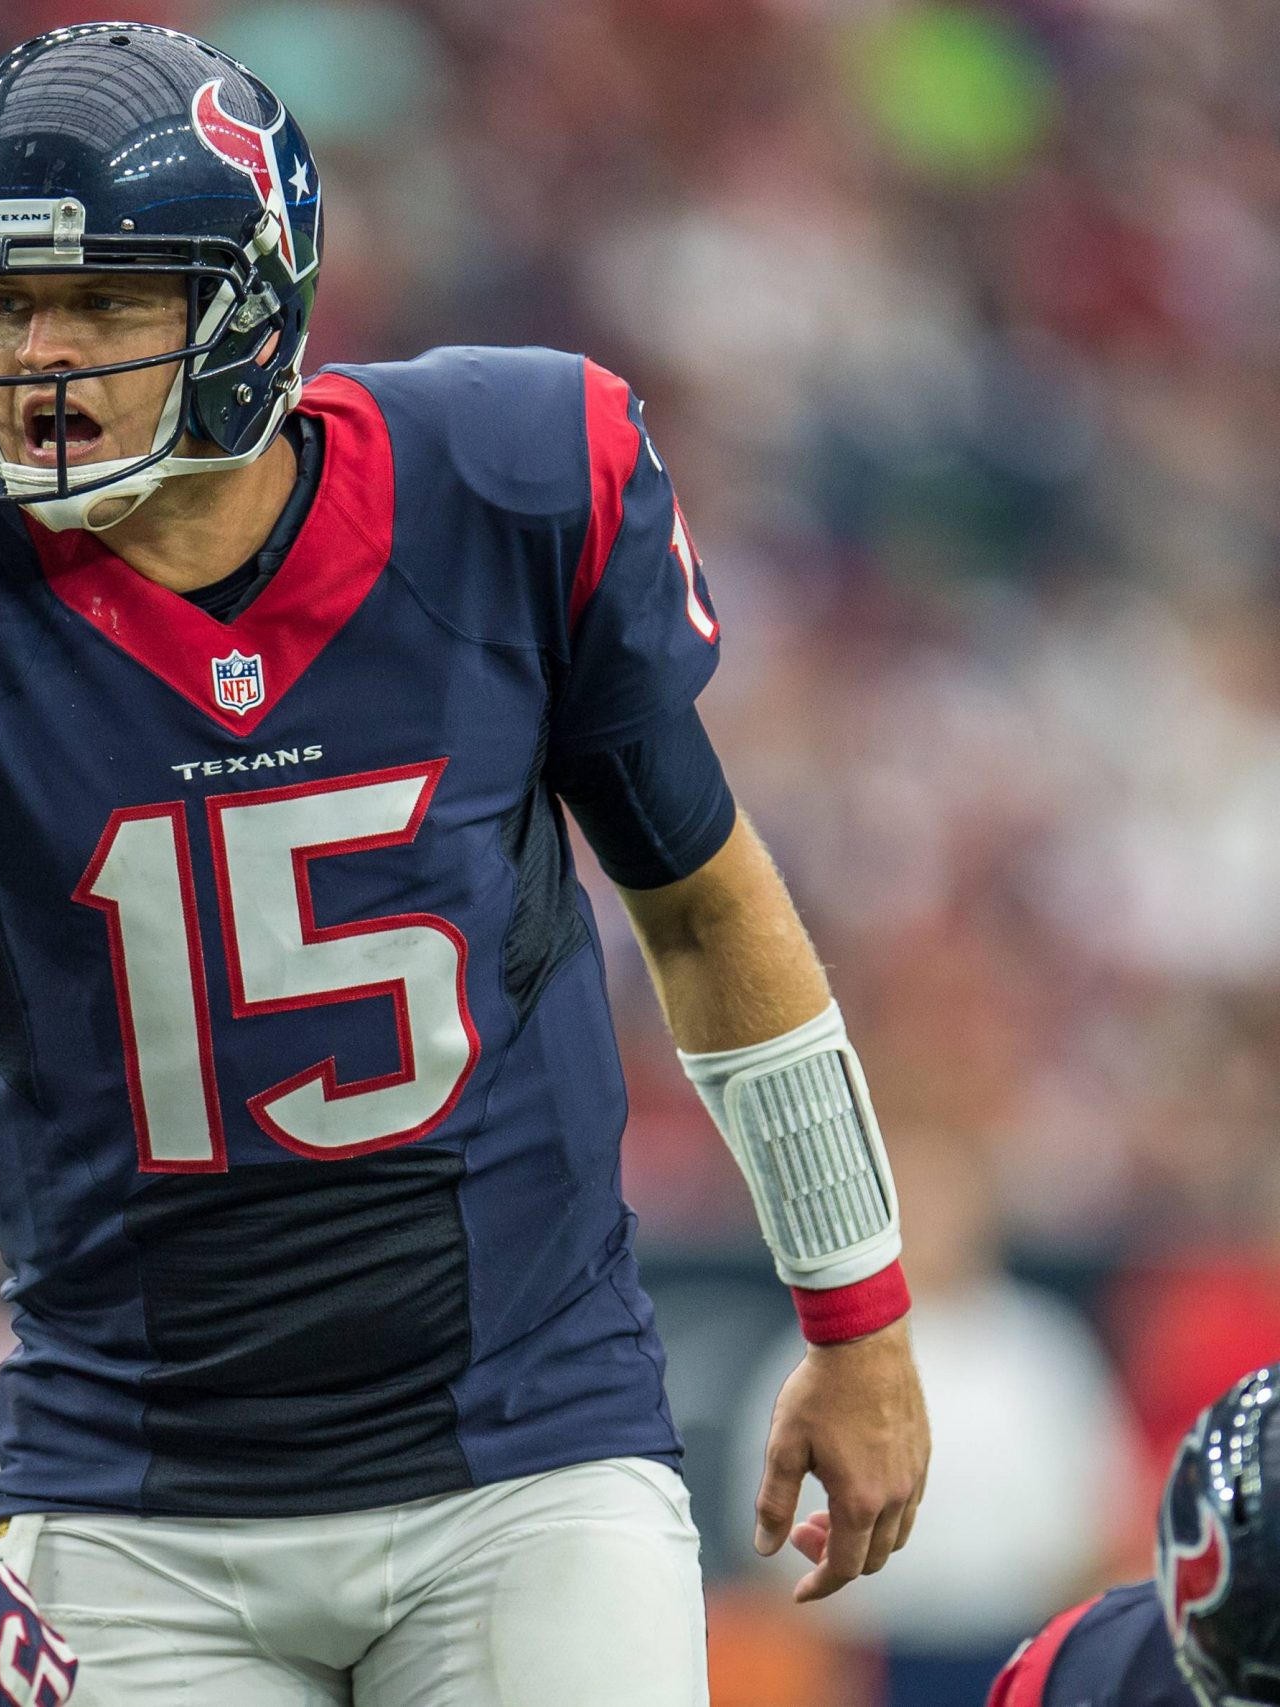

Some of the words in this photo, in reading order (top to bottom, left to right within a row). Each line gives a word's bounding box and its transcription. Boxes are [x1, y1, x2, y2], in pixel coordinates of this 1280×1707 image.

[222, 679, 257, 704] NFL
[171, 744, 323, 780] TEXANS
[71, 757, 482, 1174] 15
